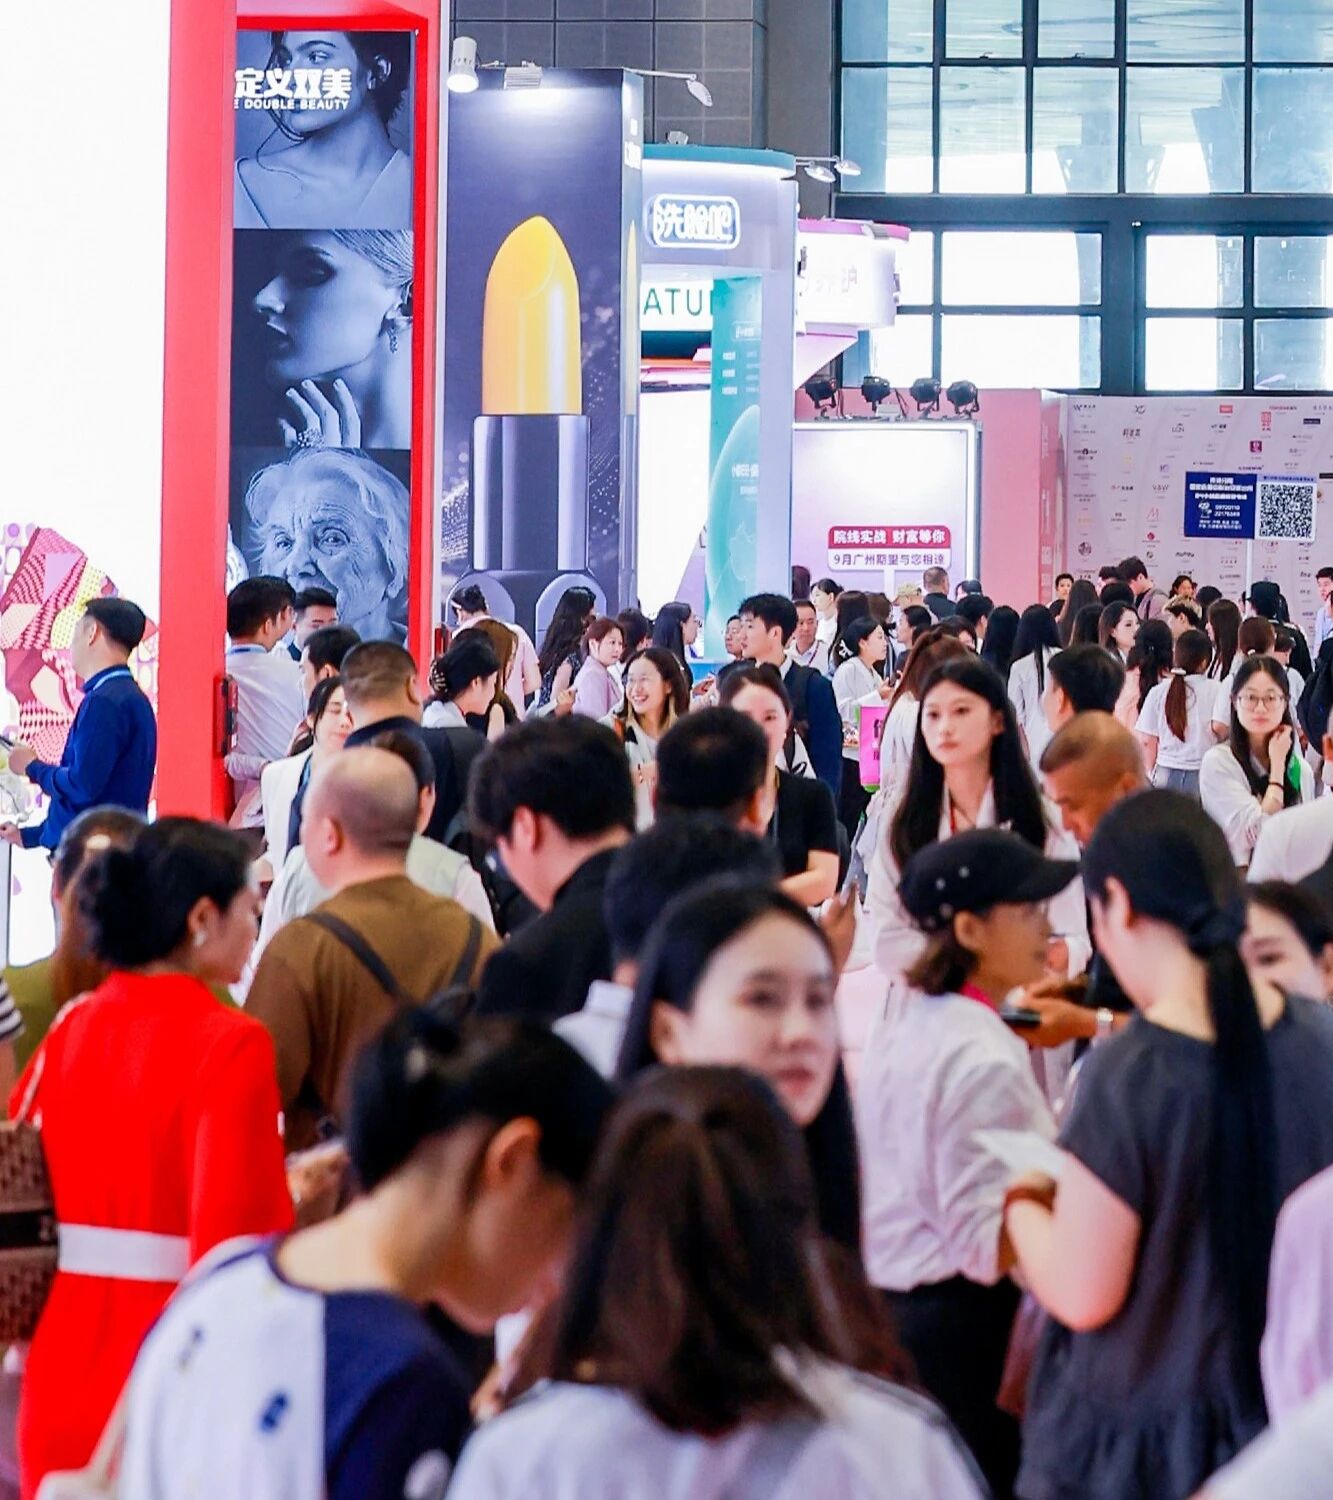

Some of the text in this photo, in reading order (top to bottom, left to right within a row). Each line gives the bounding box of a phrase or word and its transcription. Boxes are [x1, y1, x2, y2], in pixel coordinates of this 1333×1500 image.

[235, 68, 351, 99] 定义双美
[244, 99, 295, 109] DOUBLE
[300, 99, 348, 109] BEAUTY
[654, 203, 733, 240] 洗脸吧
[643, 288, 713, 316] ATU
[834, 530, 945, 544] 院线实战 财富等你
